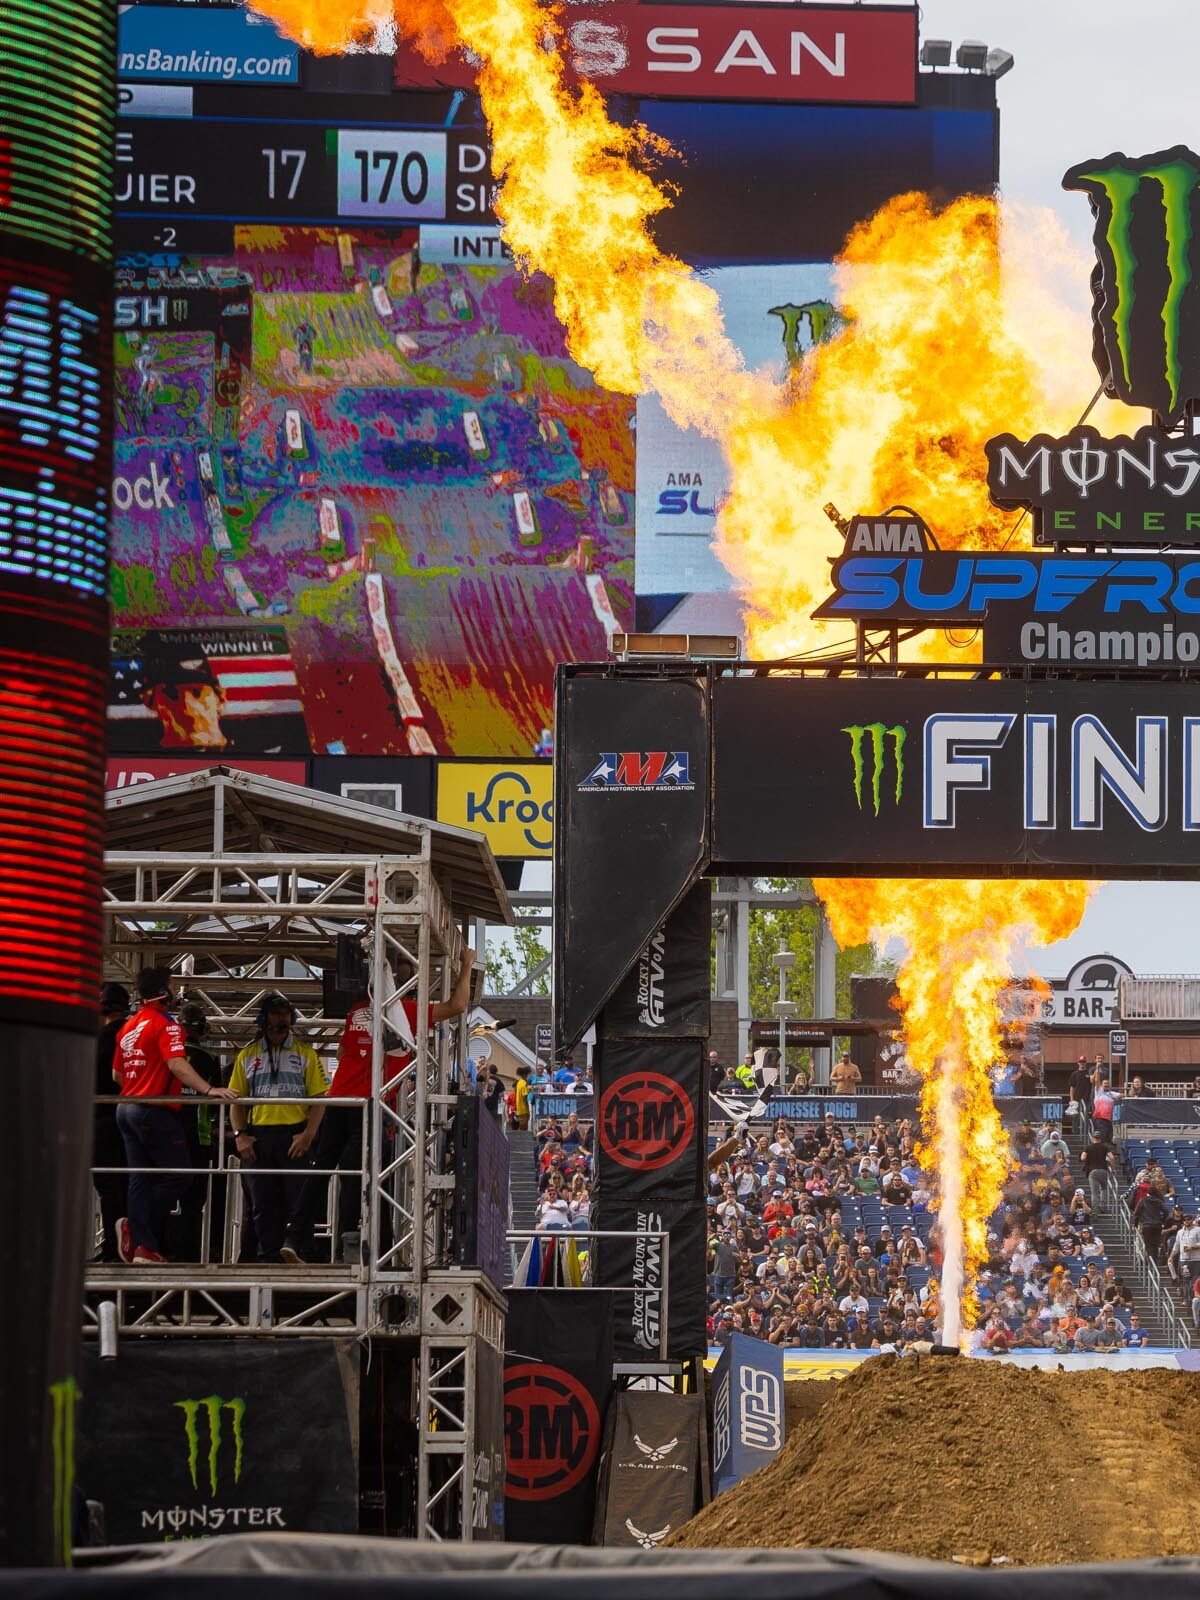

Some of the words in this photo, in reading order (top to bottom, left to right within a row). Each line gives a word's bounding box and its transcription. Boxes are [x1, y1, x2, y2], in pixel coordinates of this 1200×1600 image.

[262, 149, 307, 200] 17
[354, 150, 429, 205] 170
[112, 461, 175, 510] ock
[666, 472, 703, 487] AMA
[851, 523, 924, 553] AMA
[577, 751, 696, 787] AMA
[637, 962, 649, 1007] ROCKY
[1112, 1035, 1126, 1043] 103
[615, 1100, 676, 1141] RM
[140, 1504, 288, 1532] MONSTER
